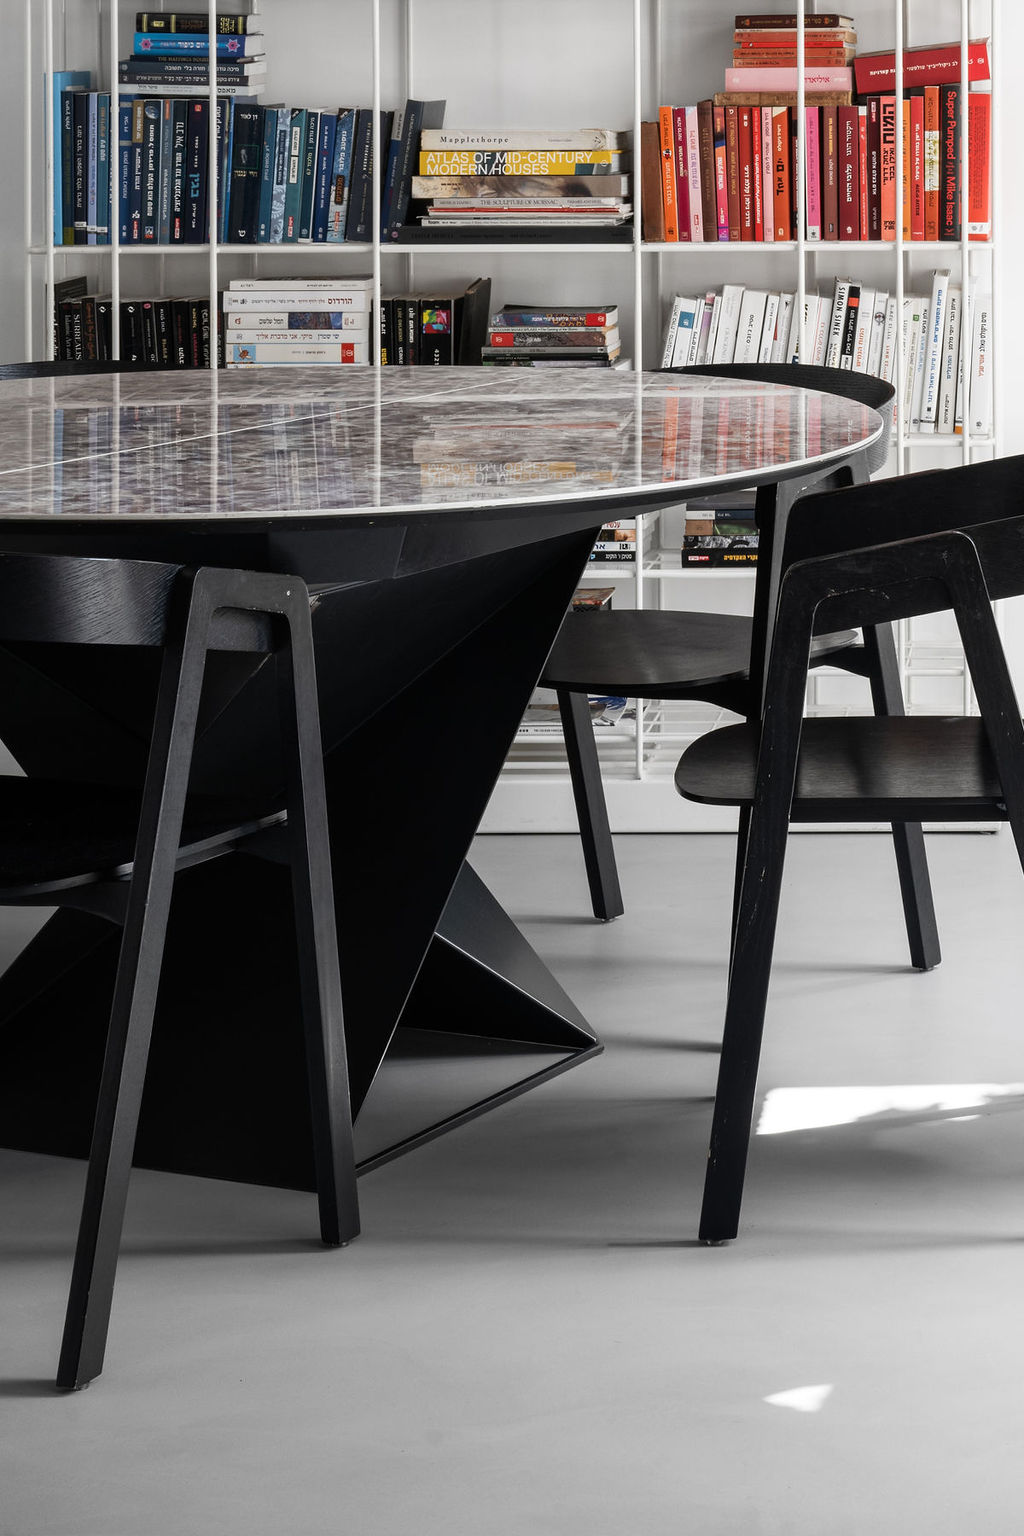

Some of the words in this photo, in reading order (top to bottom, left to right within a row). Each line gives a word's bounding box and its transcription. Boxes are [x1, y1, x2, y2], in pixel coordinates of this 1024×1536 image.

[946, 91, 957, 119] Super
[883, 103, 894, 144] המוח
[440, 136, 510, 144] Mapplethorpe
[946, 121, 957, 160] Pumped
[426, 152, 469, 164] ATLAS
[473, 151, 492, 164] OF
[494, 151, 593, 164] MID-CENTURY
[426, 164, 489, 175] MODERN
[491, 164, 550, 175] HOUSES
[946, 176, 955, 200] Mike
[946, 201, 955, 226] Isaac
[835, 286, 846, 313] SIMON
